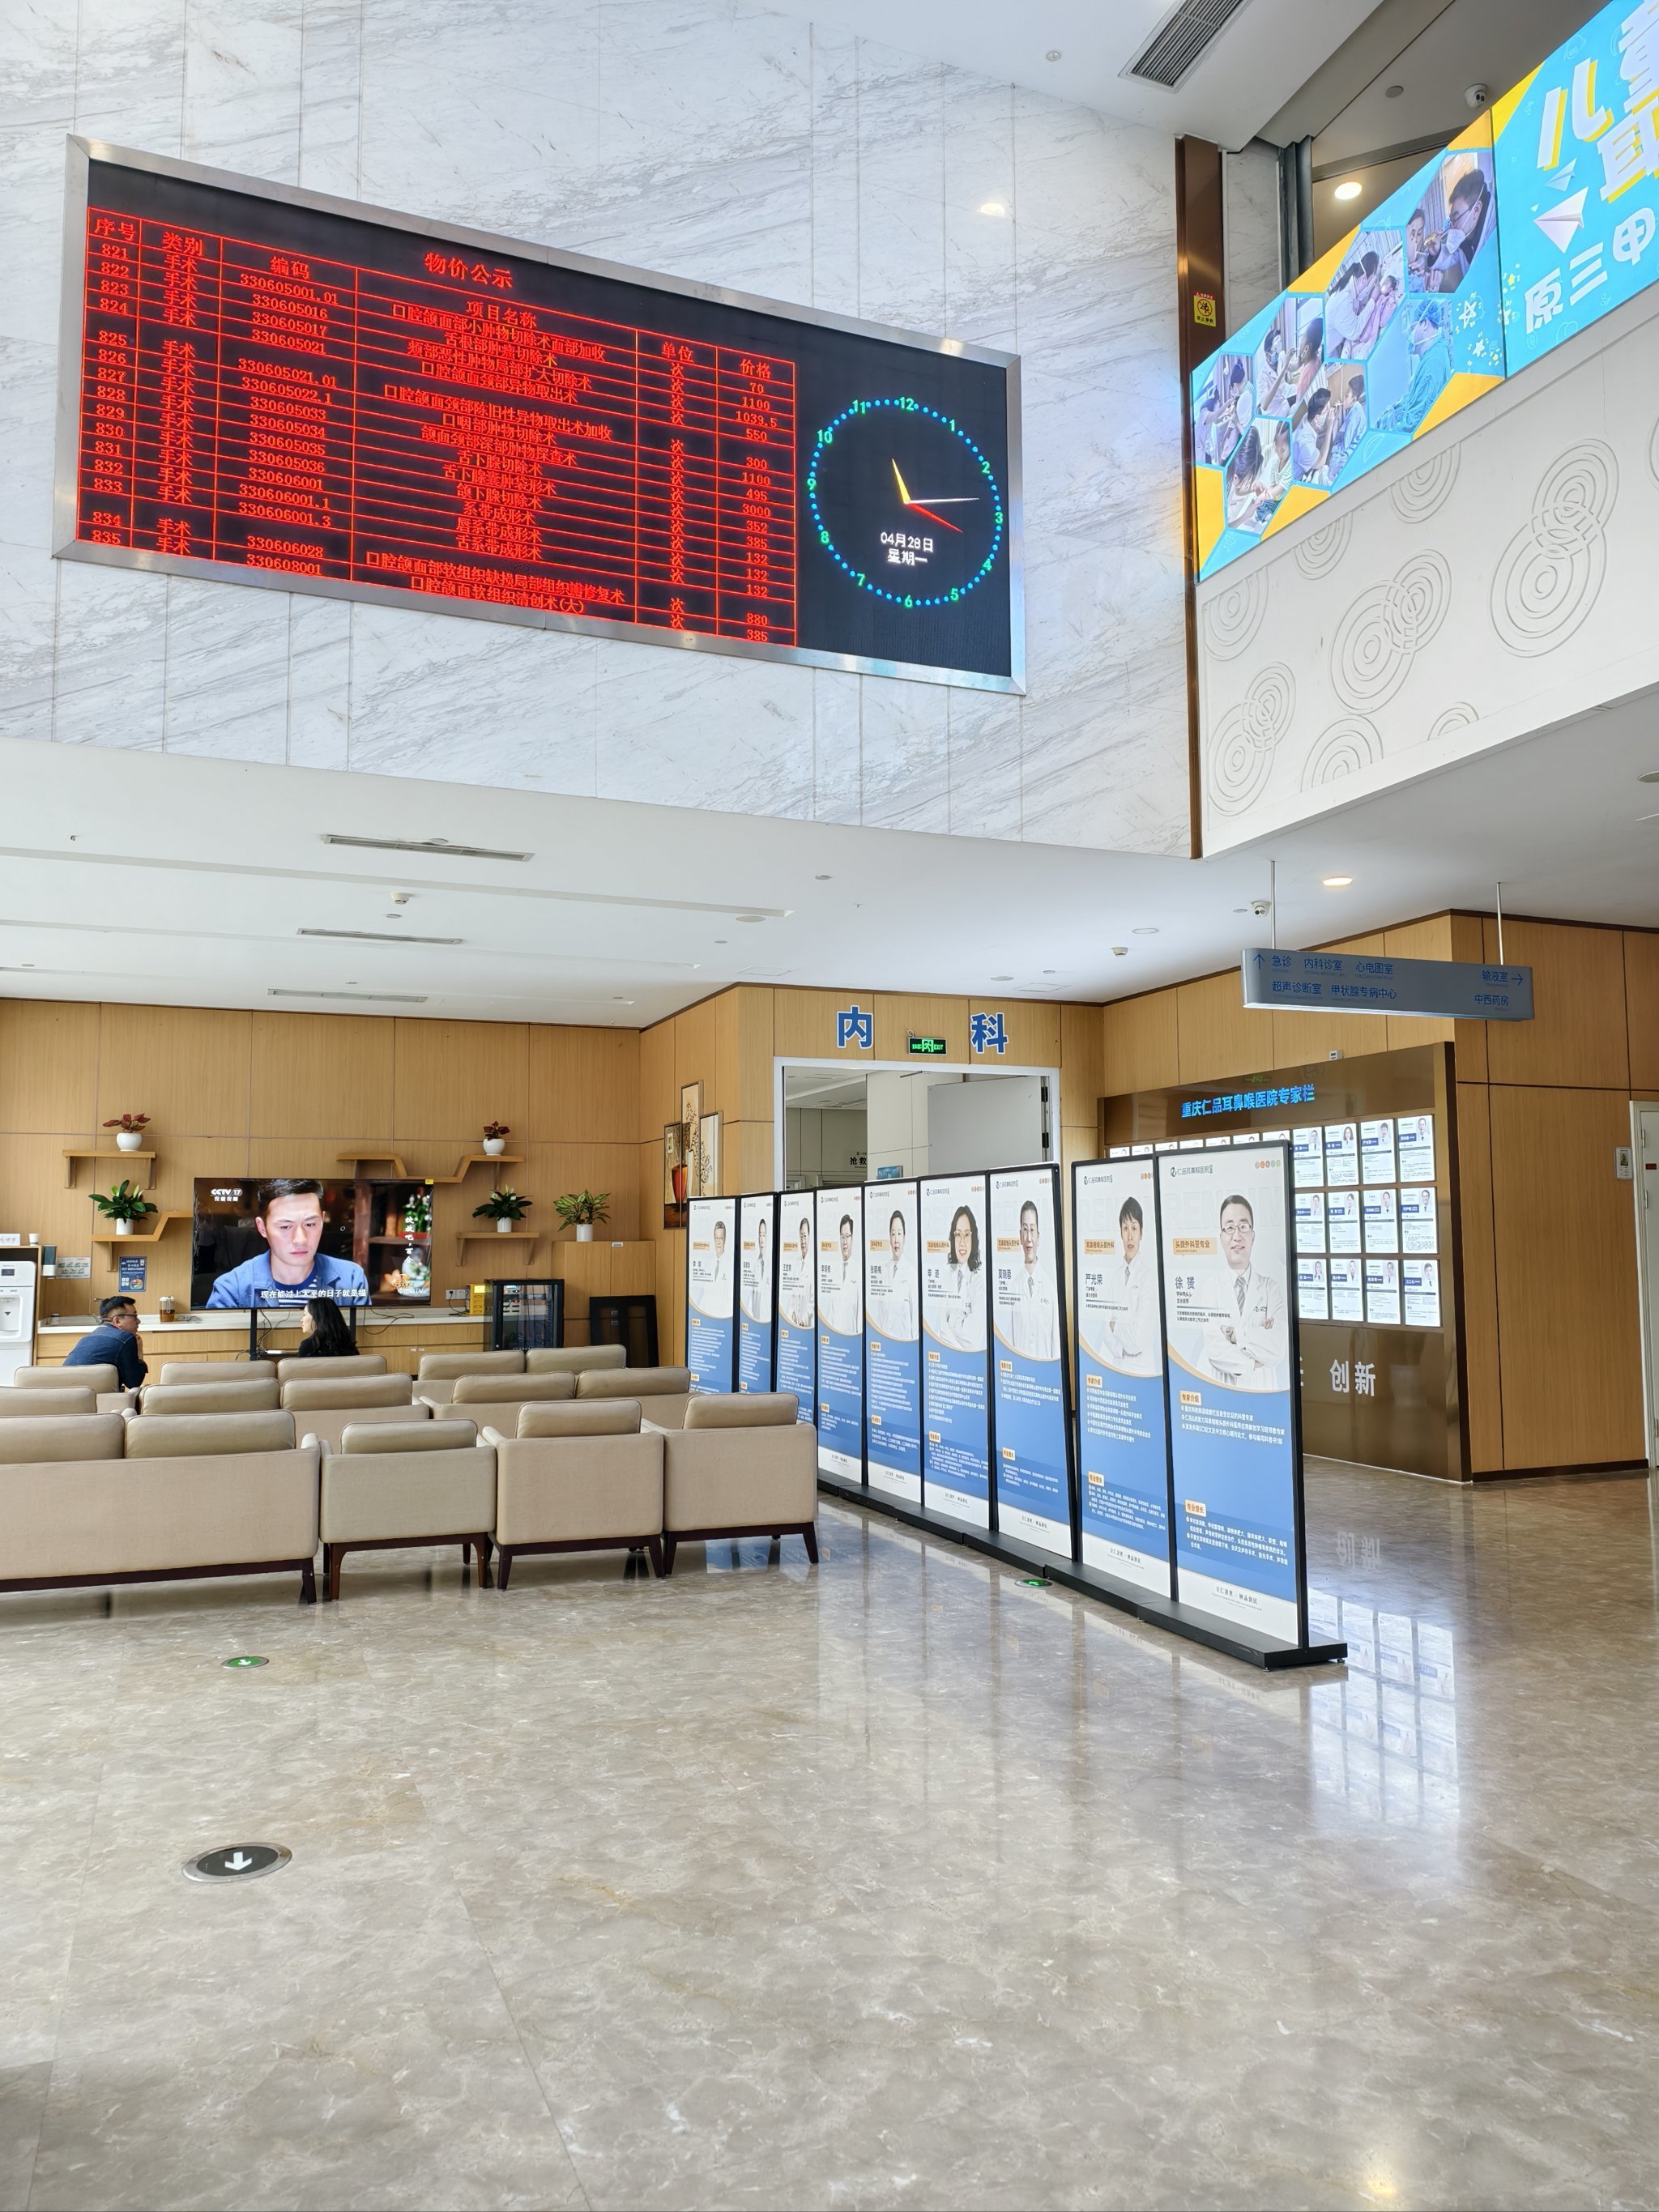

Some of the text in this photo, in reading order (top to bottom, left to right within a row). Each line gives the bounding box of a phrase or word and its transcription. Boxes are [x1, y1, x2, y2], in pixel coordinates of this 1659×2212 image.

[424, 252, 513, 288] 物价公示
[1525, 207, 1656, 334] 原三甲
[94, 218, 771, 381] 序号 类别 编码 项目名称 单位 价格
[101, 243, 128, 260] 821
[164, 254, 198, 274] 手术
[240, 273, 338, 305] 330605001.01
[671, 362, 684, 378] 次
[749, 381, 764, 394] 70
[101, 262, 770, 411] 822 手术 330605016 舌根部肿瘤切除术 次 1100
[100, 279, 129, 296] 823
[163, 289, 197, 309] 手术
[253, 311, 327, 337] 330605017
[671, 394, 684, 411] 次
[736, 411, 777, 428] 1039.5
[100, 297, 767, 442] 824 手术 330605021 口腔颌面颈部异物取出术 次 550
[99, 330, 127, 347] 825
[162, 340, 195, 359] 手术
[238, 358, 337, 388] 330605021.01
[670, 439, 684, 454] 次
[746, 457, 767, 471] 300
[99, 348, 770, 487] 826 手术 330605022.1 口咽部肿物切除术 次 1100
[852, 400, 866, 414] 11
[899, 397, 915, 411] 12
[97, 367, 767, 501] 827 手术 330605033 颌面颈部深部肿物探查术 次 495
[817, 430, 833, 444] 10
[949, 420, 955, 432] 1
[96, 403, 768, 534] 829 手术 330605035 舌下腺囊肿袋形术 次 352
[97, 386, 770, 518] 828 手术 330605034 舌下腺切除术 次 3000
[982, 462, 990, 474] 2
[96, 422, 768, 549] 830 手术 330605036 颌下腺切除术 次 385
[807, 478, 817, 491] 9
[95, 441, 768, 565] 831 手术 330606001 系带成形术 次 132
[95, 458, 767, 582] 832 手术 330606001.1 唇系带成形术 次 132
[995, 512, 1003, 524] 3
[94, 478, 768, 598] 833 手术 330606001.3 舌系带成形术 次 132
[821, 531, 830, 544] 8
[881, 532, 933, 552] 04月28日
[92, 511, 122, 526] 834
[157, 518, 191, 537] 手术
[247, 535, 323, 558] 330606028
[670, 598, 684, 614] 次
[747, 612, 768, 626] 880
[887, 548, 928, 565] 星期一
[983, 559, 992, 571] 4
[92, 530, 121, 544] 835
[156, 536, 190, 554] 手术
[246, 553, 322, 575] 330608001
[670, 613, 684, 630] 次
[747, 629, 768, 642] 385
[857, 573, 866, 586] 7
[950, 589, 959, 601] 5
[904, 595, 913, 607] 6
[1272, 955, 1508, 982] 急诊 内科诊室 心电图室 输液室
[1272, 981, 1321, 995] 超声诊断室
[1331, 985, 1397, 999] 甲状腺专病中心
[1474, 995, 1508, 1006] 中西药房
[1181, 1084, 1315, 1119] 重庆仁品耳鼻喉医院专家栏
[260, 1289, 367, 1299] 现在能过上太平的日子就是福
[1329, 1359, 1376, 1397] 创新
